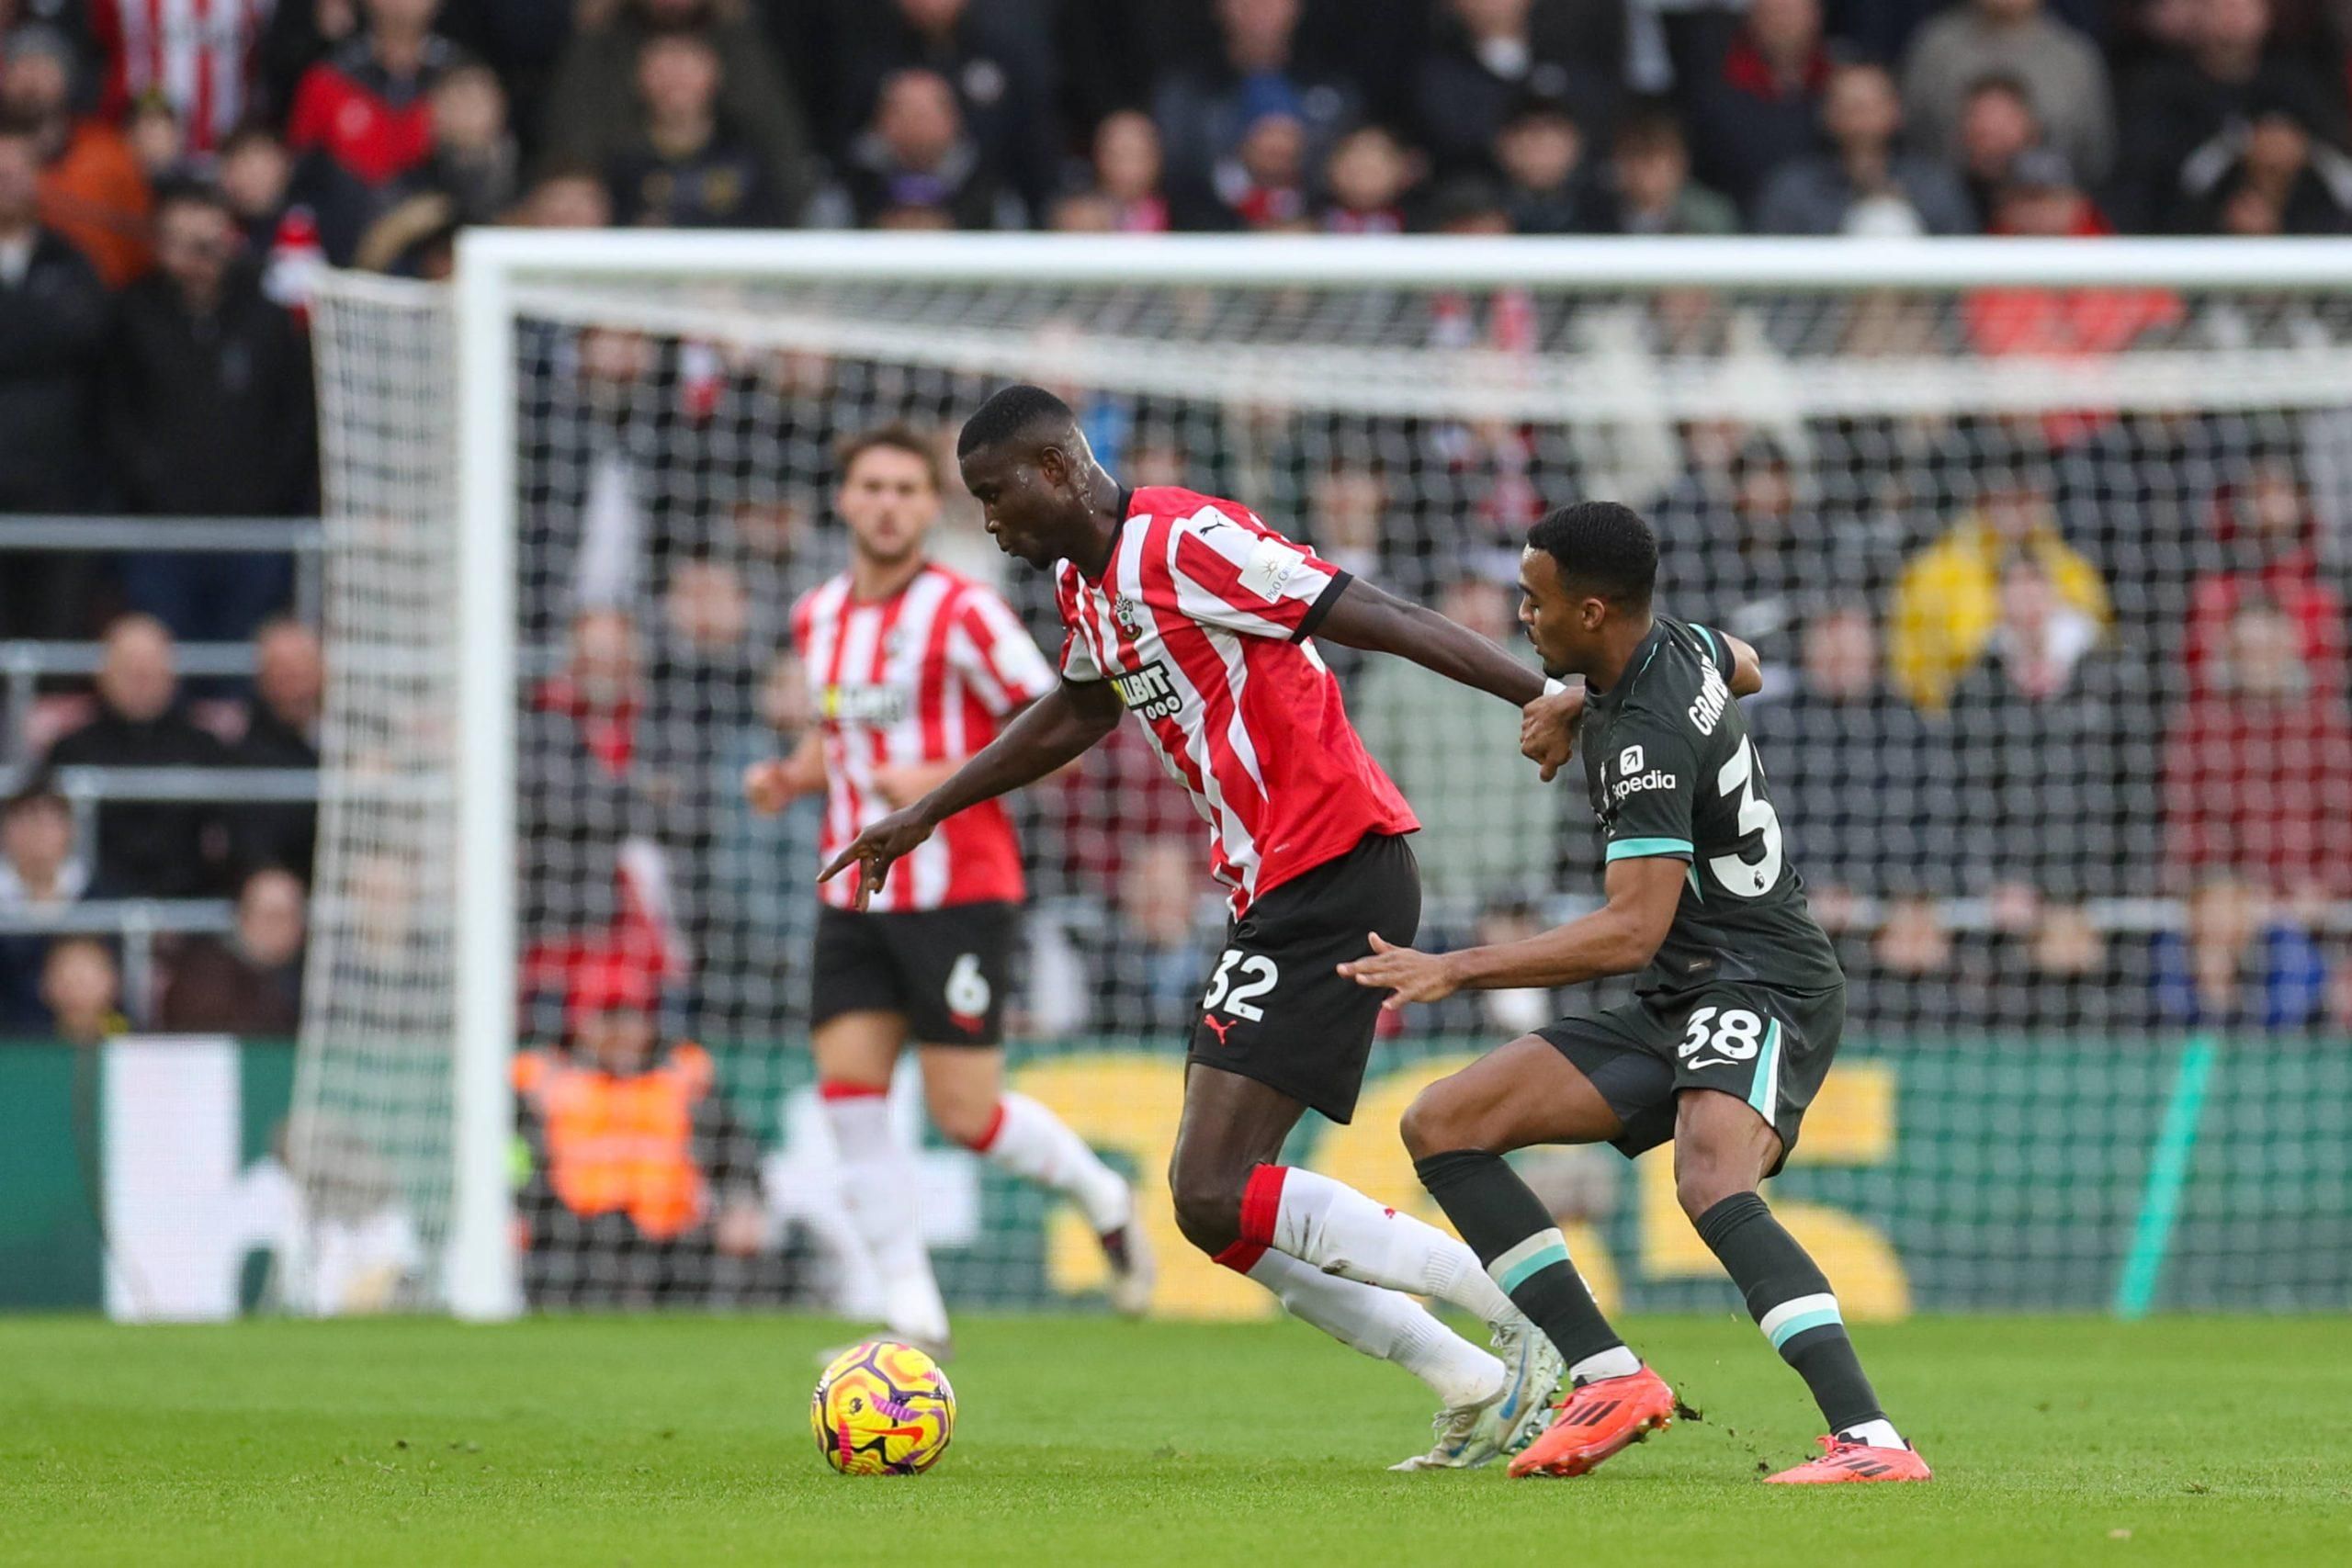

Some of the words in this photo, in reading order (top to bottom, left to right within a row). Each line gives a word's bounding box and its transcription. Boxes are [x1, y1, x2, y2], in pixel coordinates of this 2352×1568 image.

[1709, 733, 1782, 897] 3
[944, 953, 990, 1016] 6
[1203, 949, 1278, 1022] 32
[1678, 1006, 1762, 1060] 38
